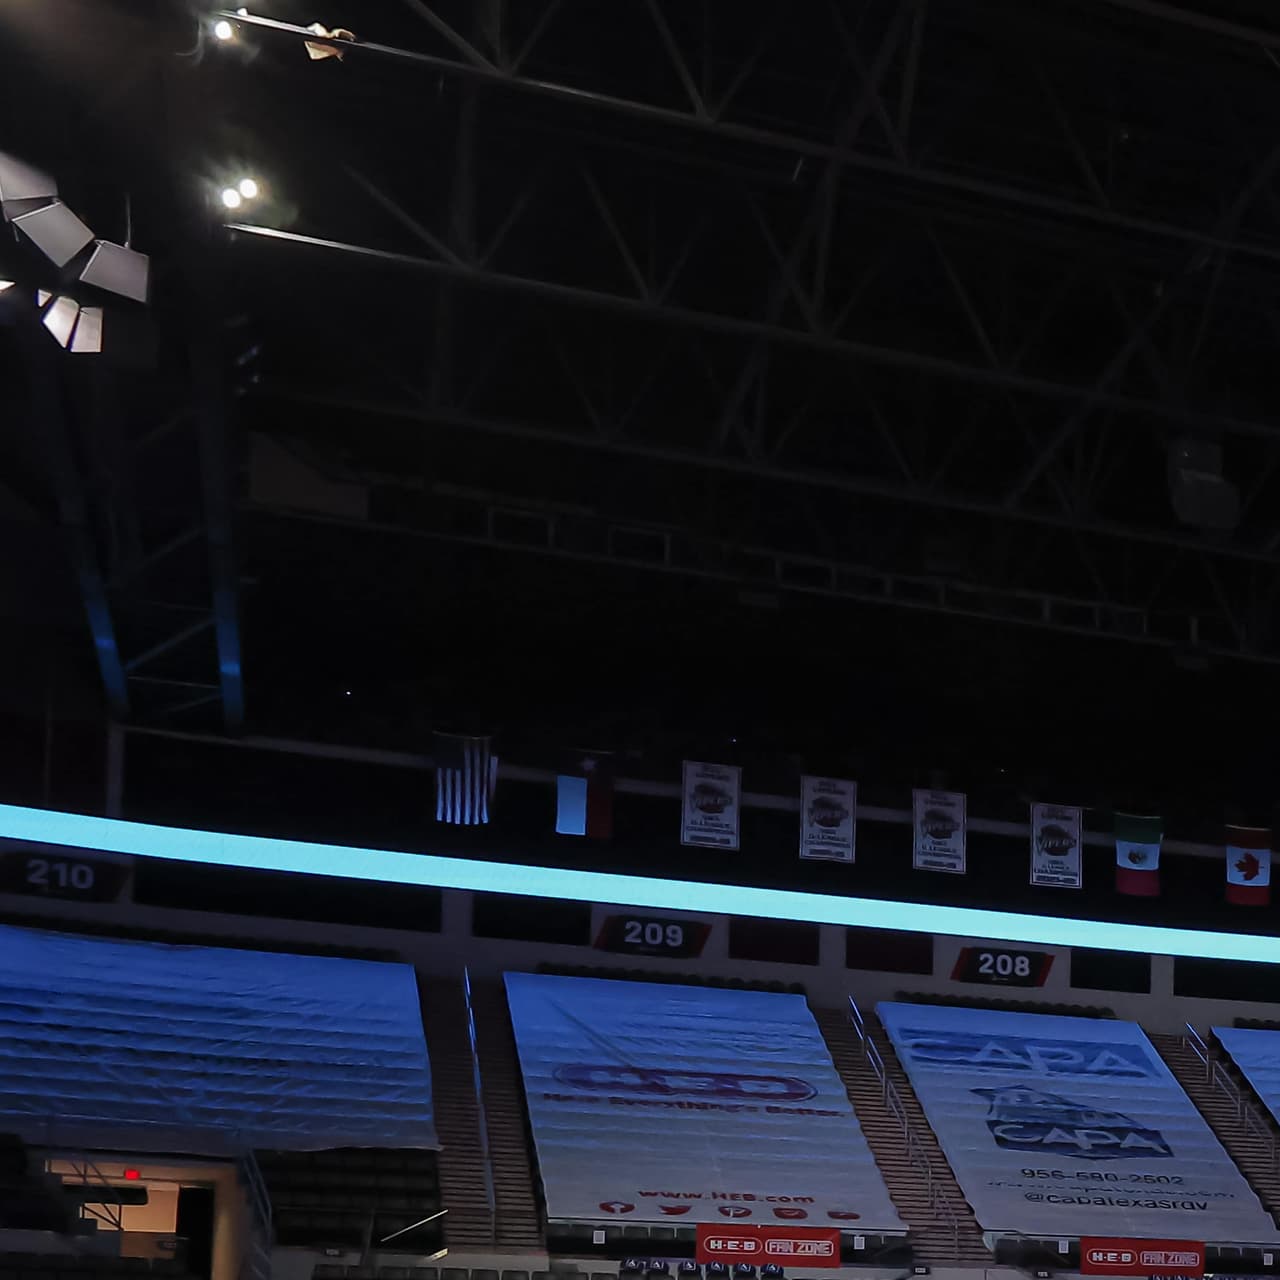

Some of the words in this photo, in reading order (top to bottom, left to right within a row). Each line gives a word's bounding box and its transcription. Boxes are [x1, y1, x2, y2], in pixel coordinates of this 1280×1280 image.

[26, 858, 95, 891] 210
[624, 920, 684, 947] 209
[978, 952, 1031, 979] 208
[994, 1124, 1170, 1156] CAPA
[768, 1241, 796, 1254] FAN
[797, 1242, 833, 1256] ZONE
[1168, 1253, 1199, 1266] ZONE
